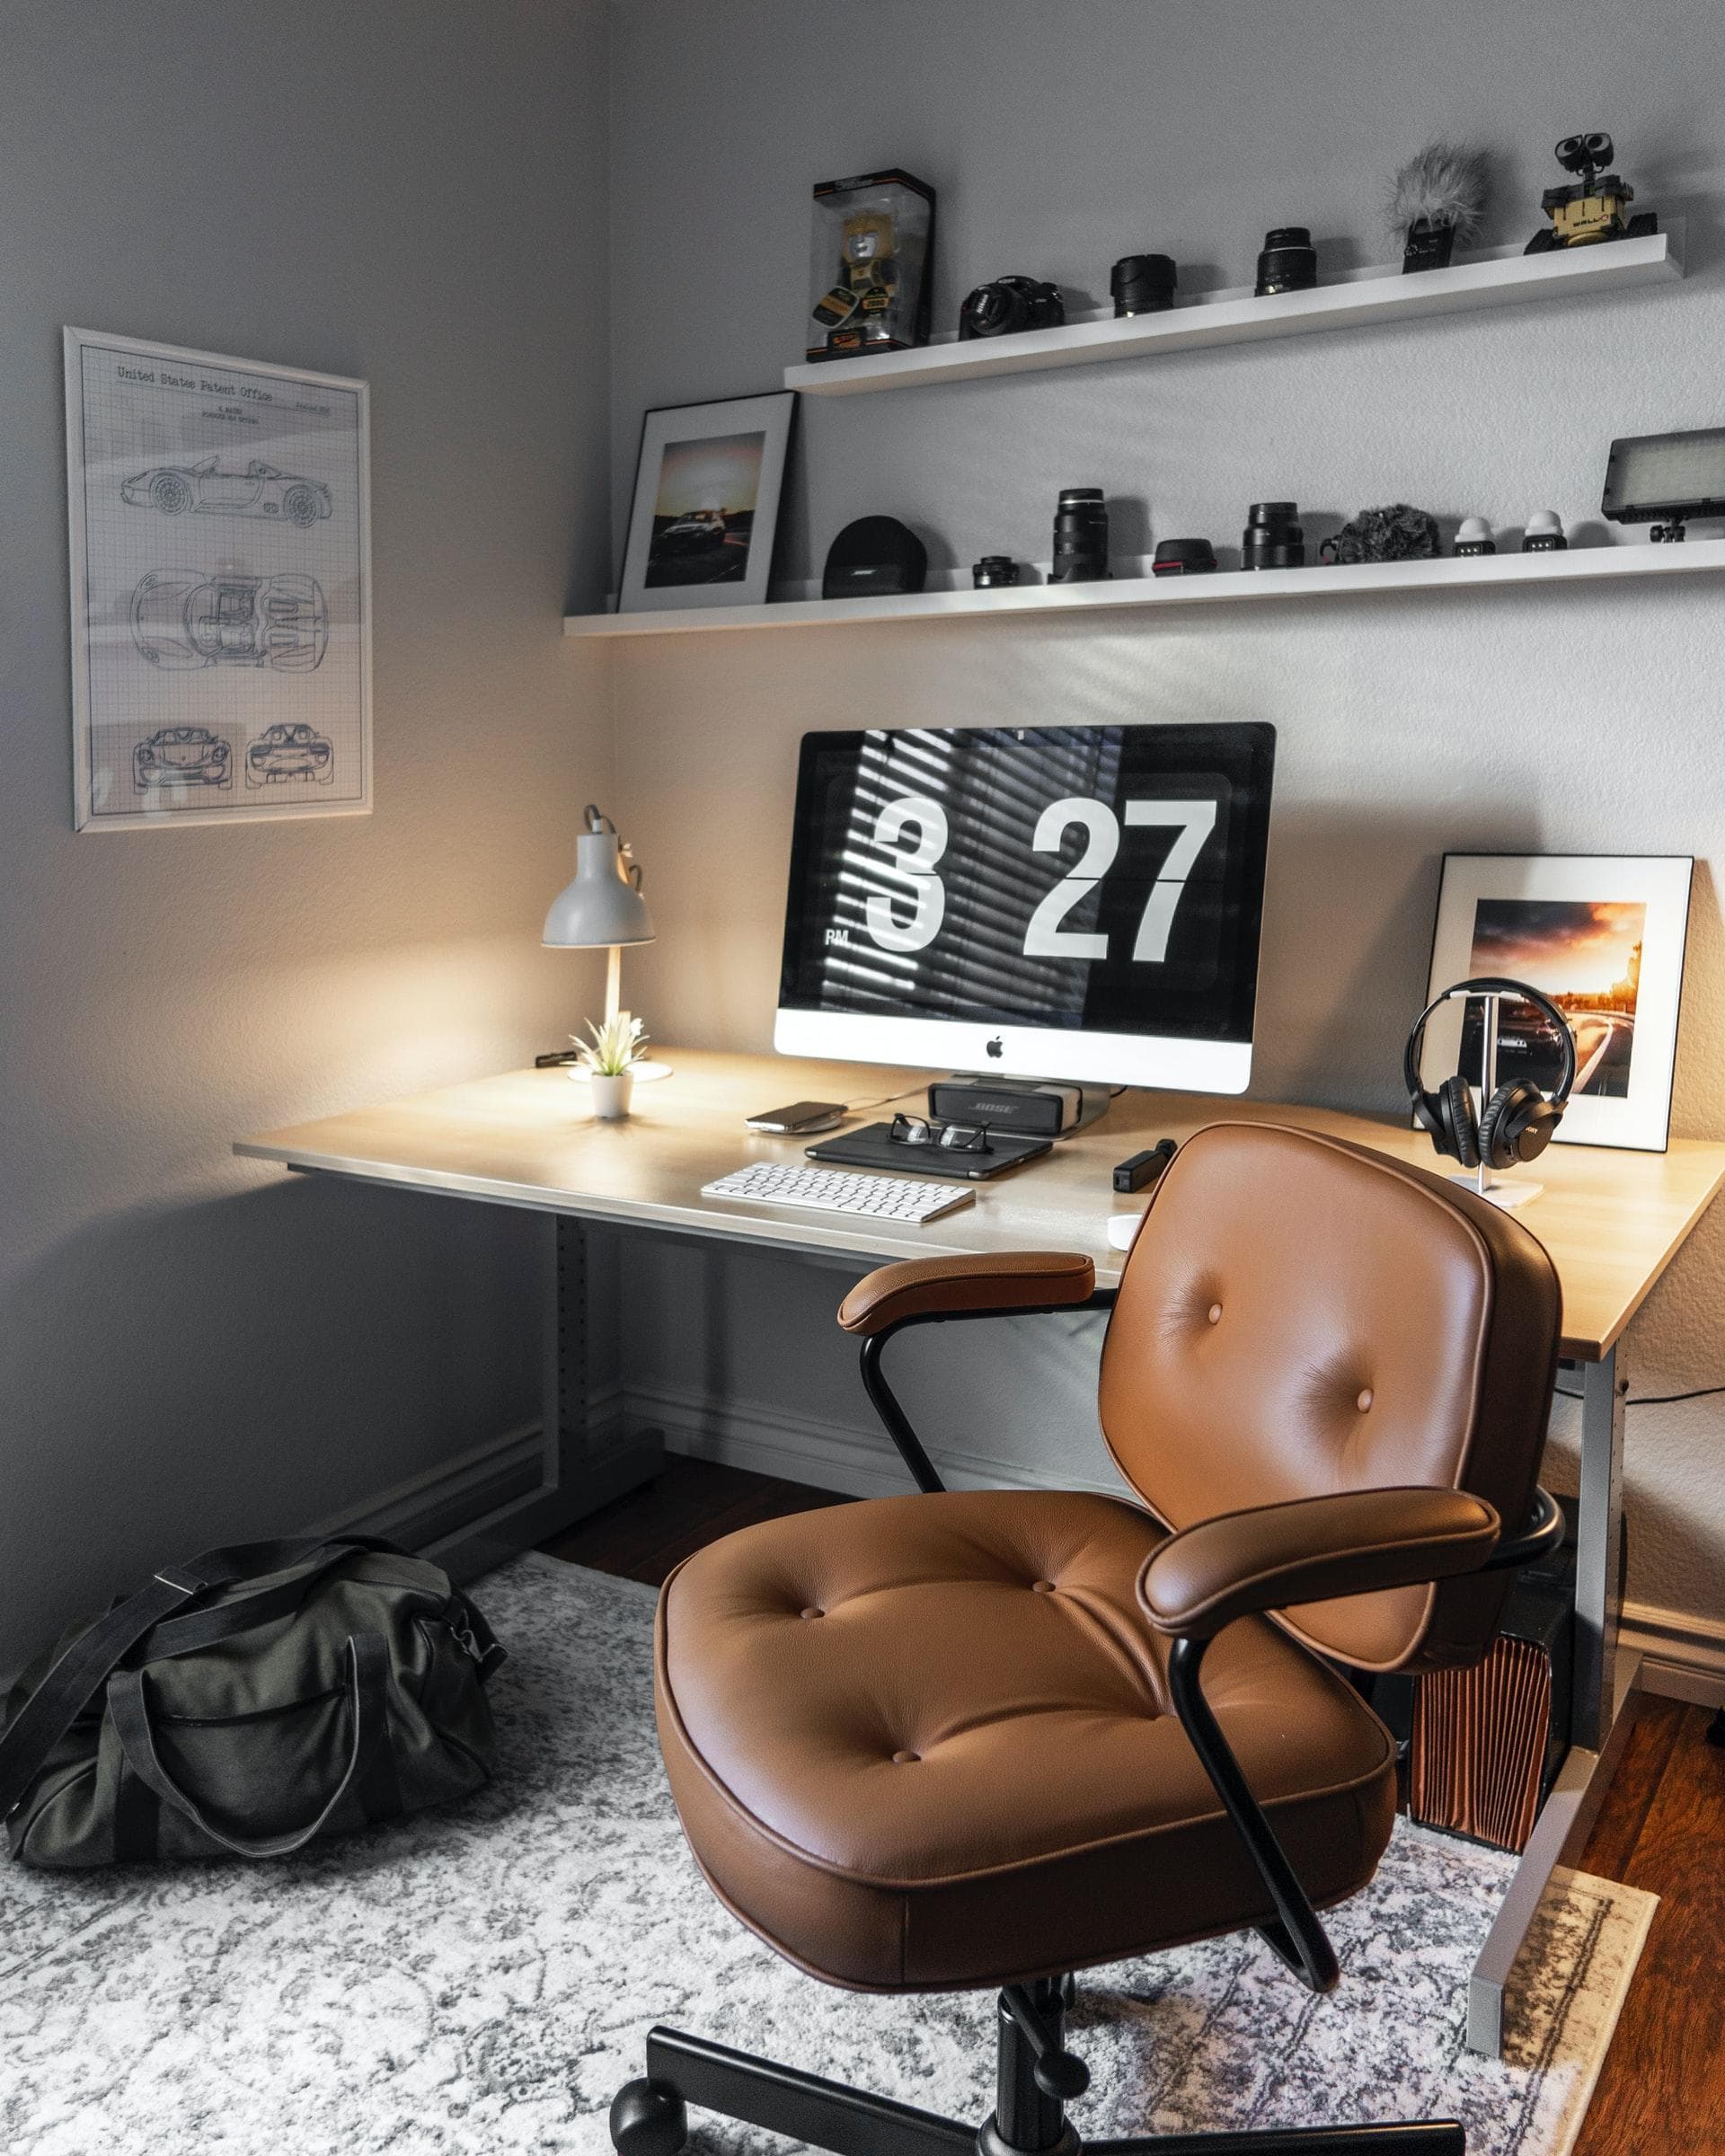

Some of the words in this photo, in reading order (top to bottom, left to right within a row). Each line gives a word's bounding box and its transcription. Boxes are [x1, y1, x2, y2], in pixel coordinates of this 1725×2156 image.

[117, 367, 155, 383] United
[161, 374, 195, 390] States
[200, 380, 236, 396] Patent
[240, 386, 273, 402] Office
[866, 797, 949, 952] 3
[1023, 798, 1217, 963] 27
[825, 929, 849, 946] PM
[970, 1102, 1018, 1114] BOSE
